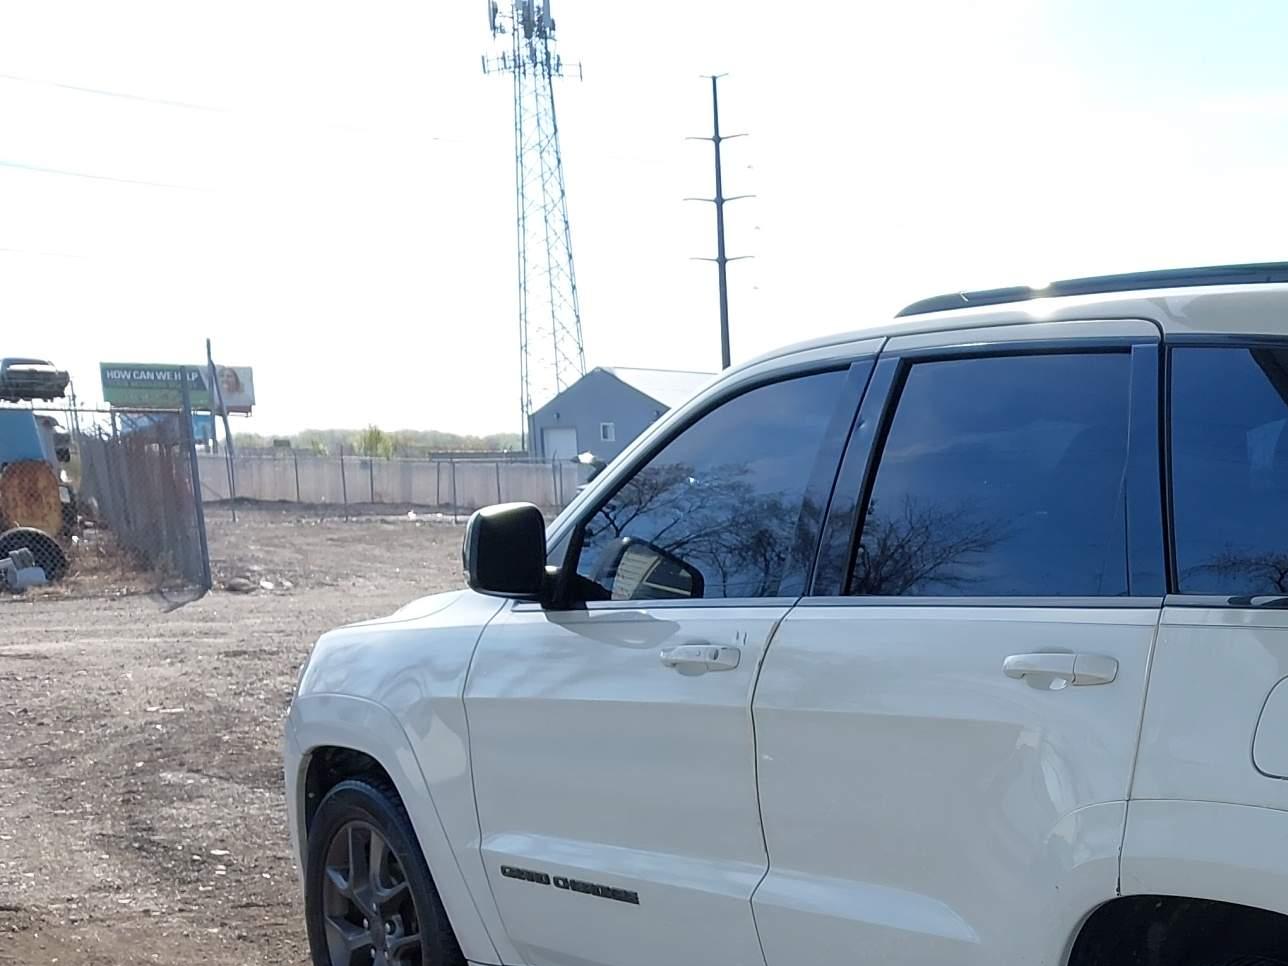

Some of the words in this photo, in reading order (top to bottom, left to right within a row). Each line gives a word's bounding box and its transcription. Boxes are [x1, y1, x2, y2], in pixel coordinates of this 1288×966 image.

[106, 370, 131, 379] HOW
[133, 371, 154, 380] CAN
[155, 371, 174, 380] WE
[174, 371, 199, 381] HLP
